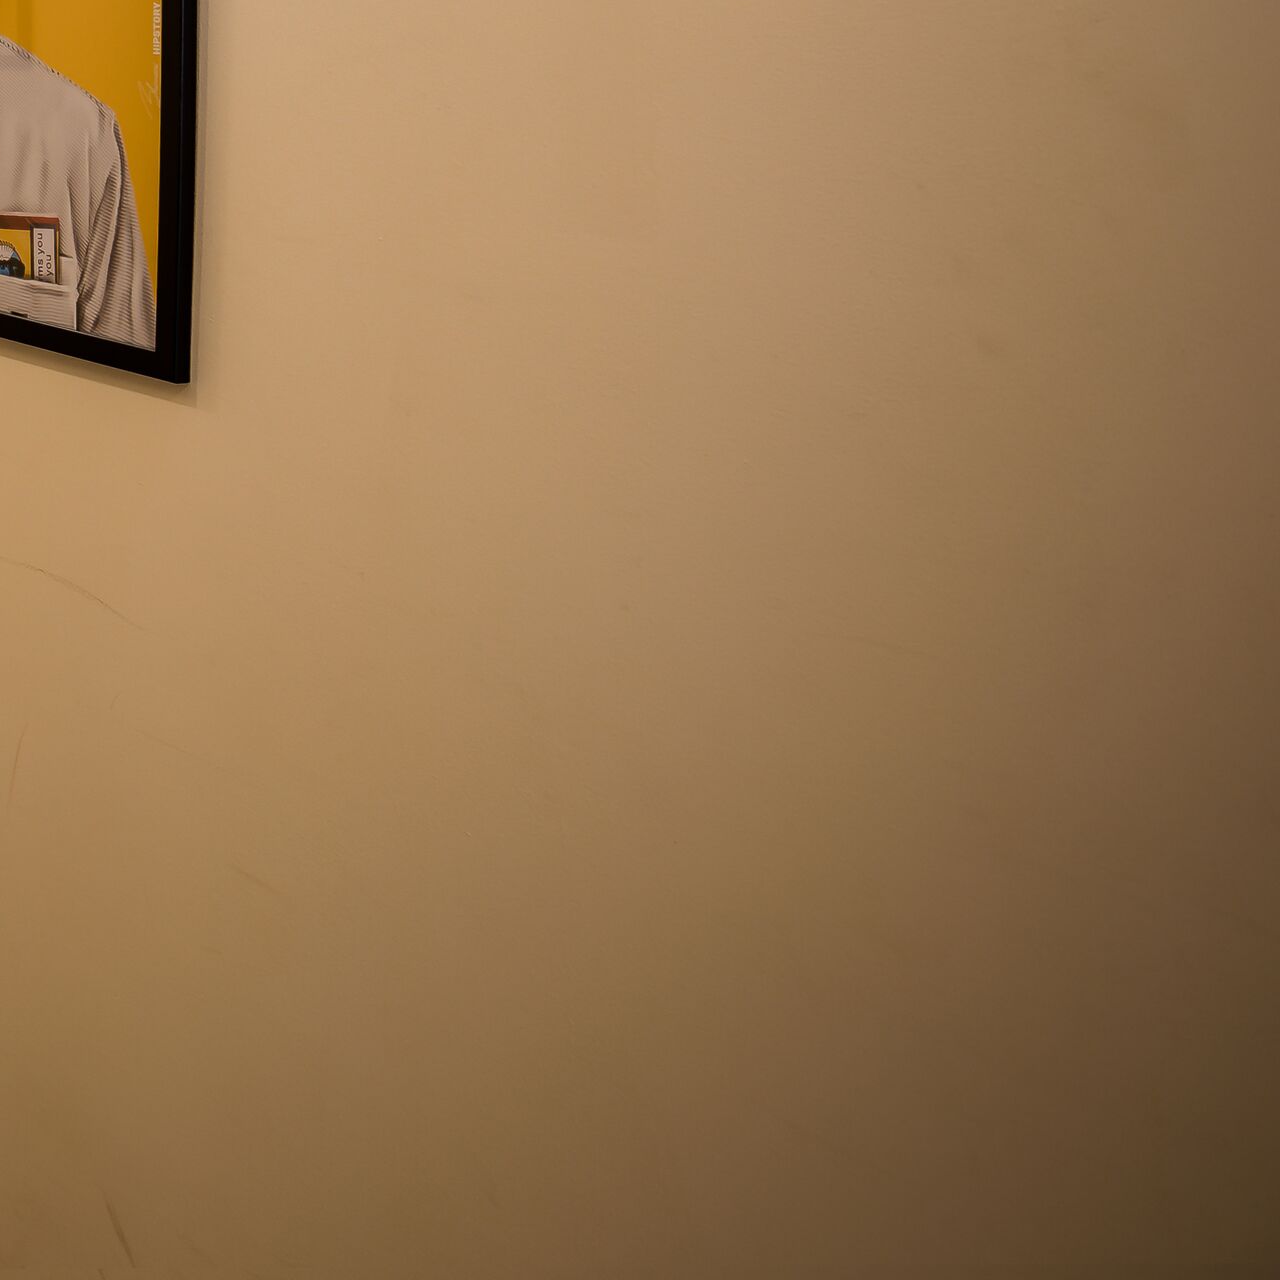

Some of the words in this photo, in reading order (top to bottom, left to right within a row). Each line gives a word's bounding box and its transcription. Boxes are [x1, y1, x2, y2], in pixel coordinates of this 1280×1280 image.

[152, 1, 161, 55] HIPSTORY
[37, 232, 45, 255] you
[46, 254, 54, 277] you
